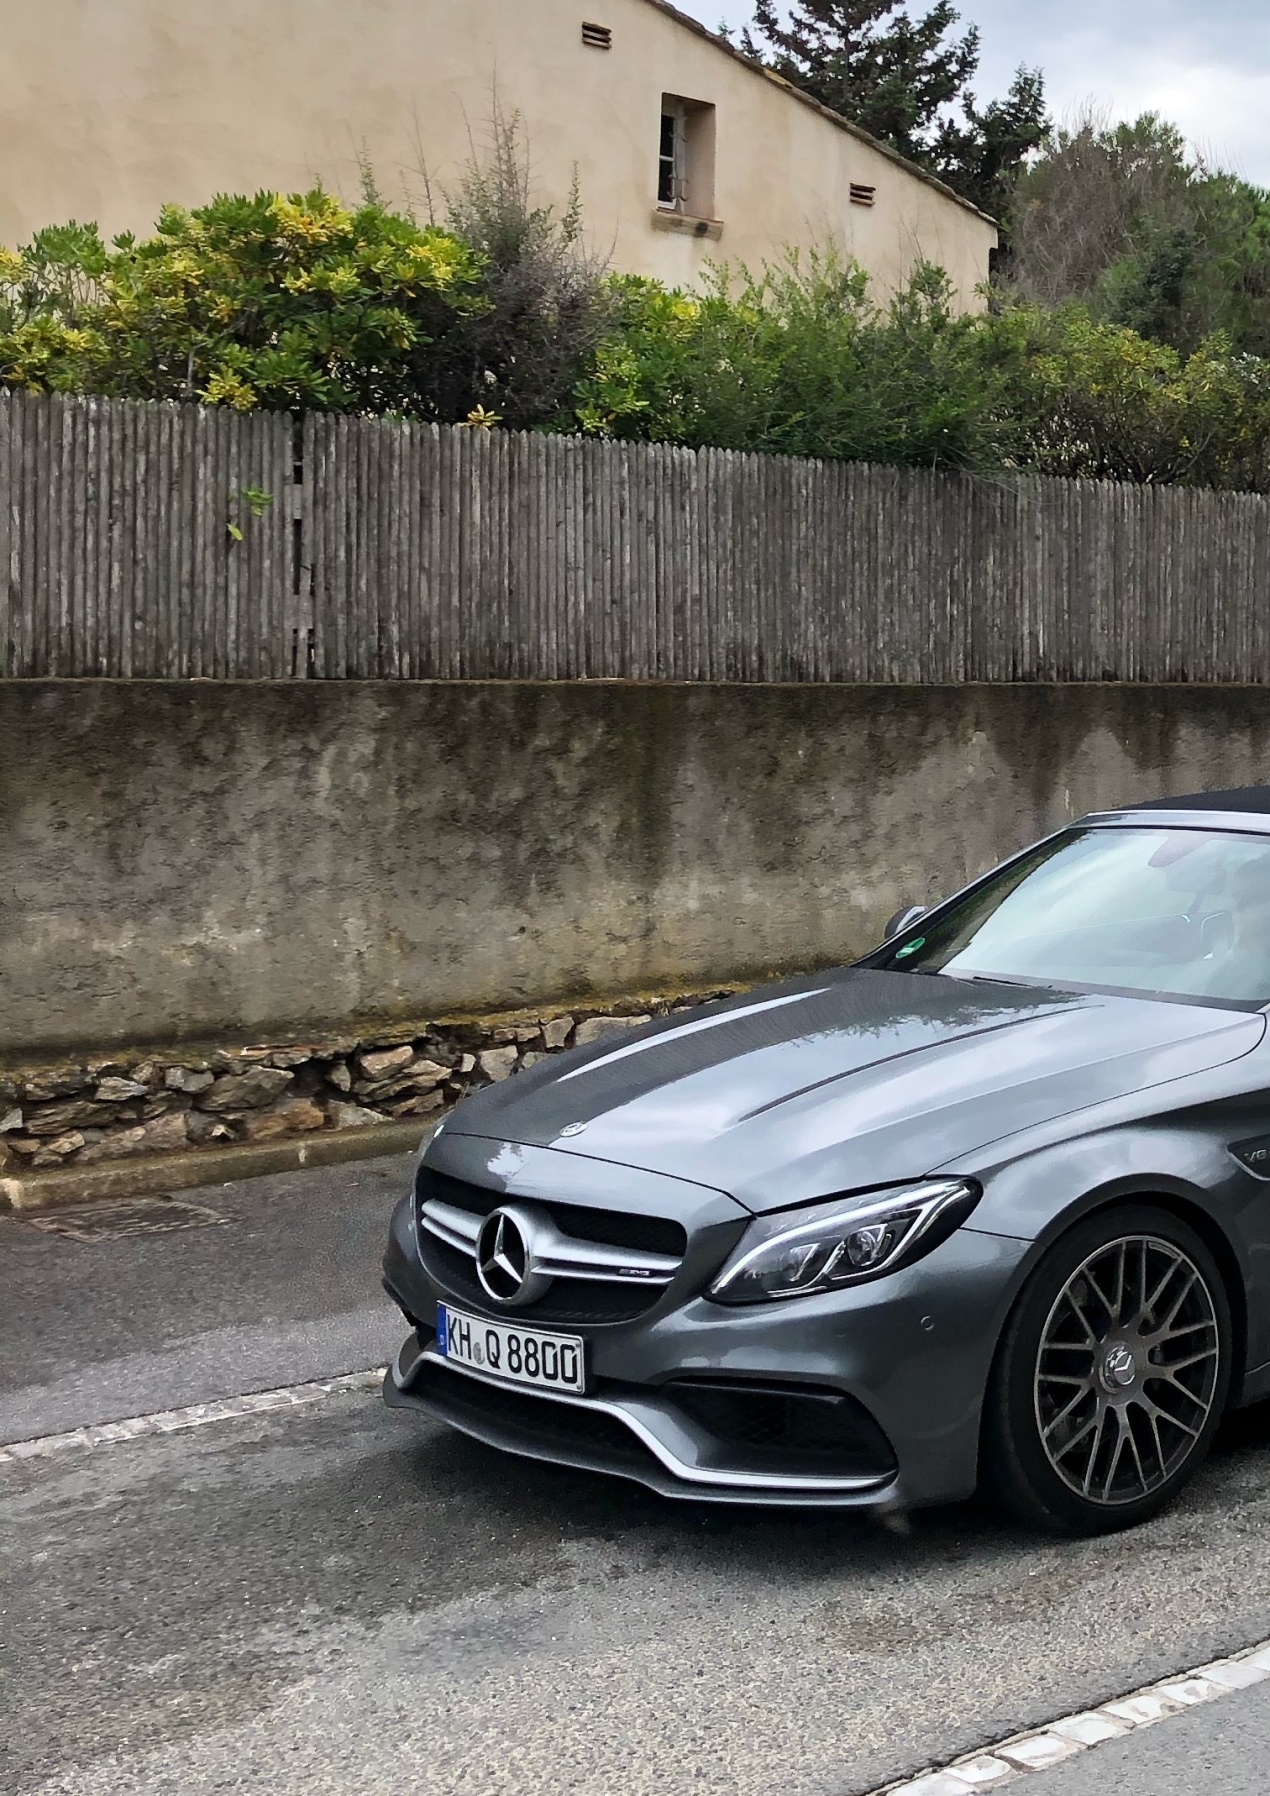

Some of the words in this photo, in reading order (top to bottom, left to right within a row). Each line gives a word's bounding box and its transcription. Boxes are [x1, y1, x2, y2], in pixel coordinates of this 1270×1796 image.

[447, 1313, 472, 1360] KH
[485, 1329, 501, 1370] Q
[507, 1334, 578, 1385] 8800
